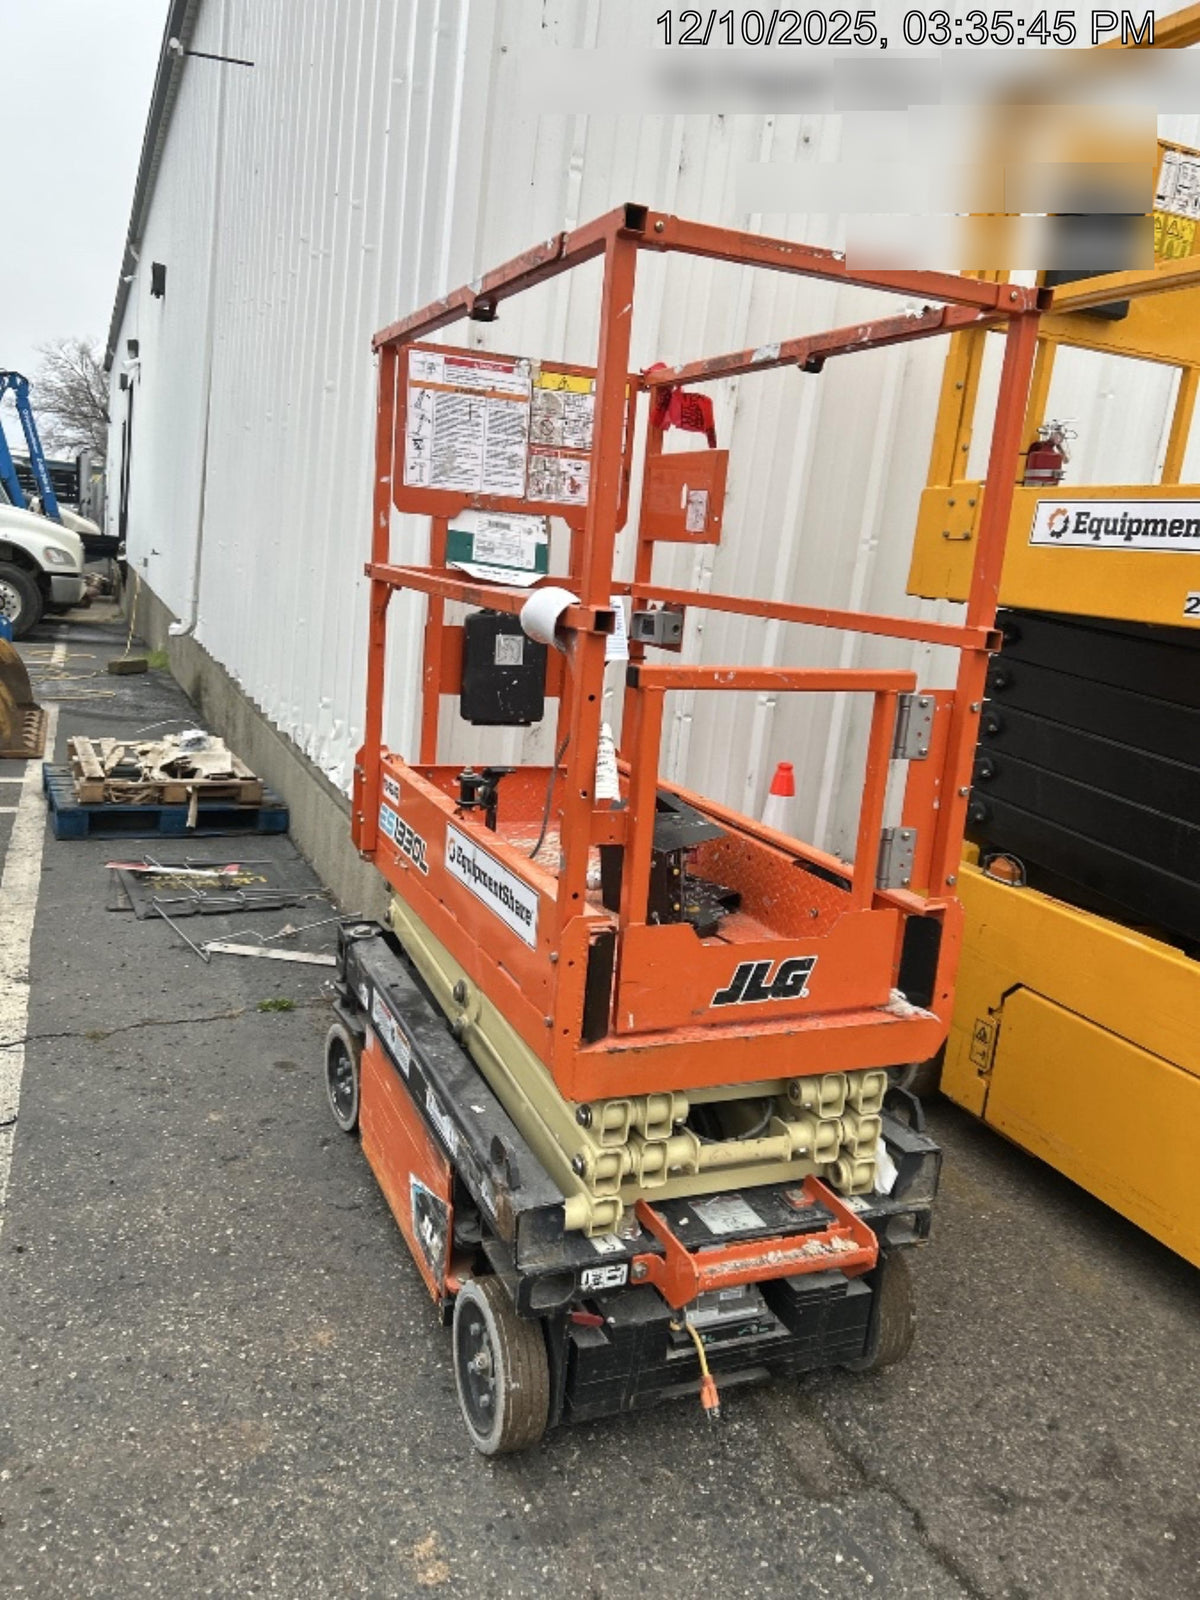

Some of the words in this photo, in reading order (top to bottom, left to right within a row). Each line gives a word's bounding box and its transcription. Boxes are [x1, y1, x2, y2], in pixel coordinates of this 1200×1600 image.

[1072, 511, 1200, 541] Equipmen
[456, 844, 533, 927] EquipmentShare
[709, 954, 818, 1008] JLG
